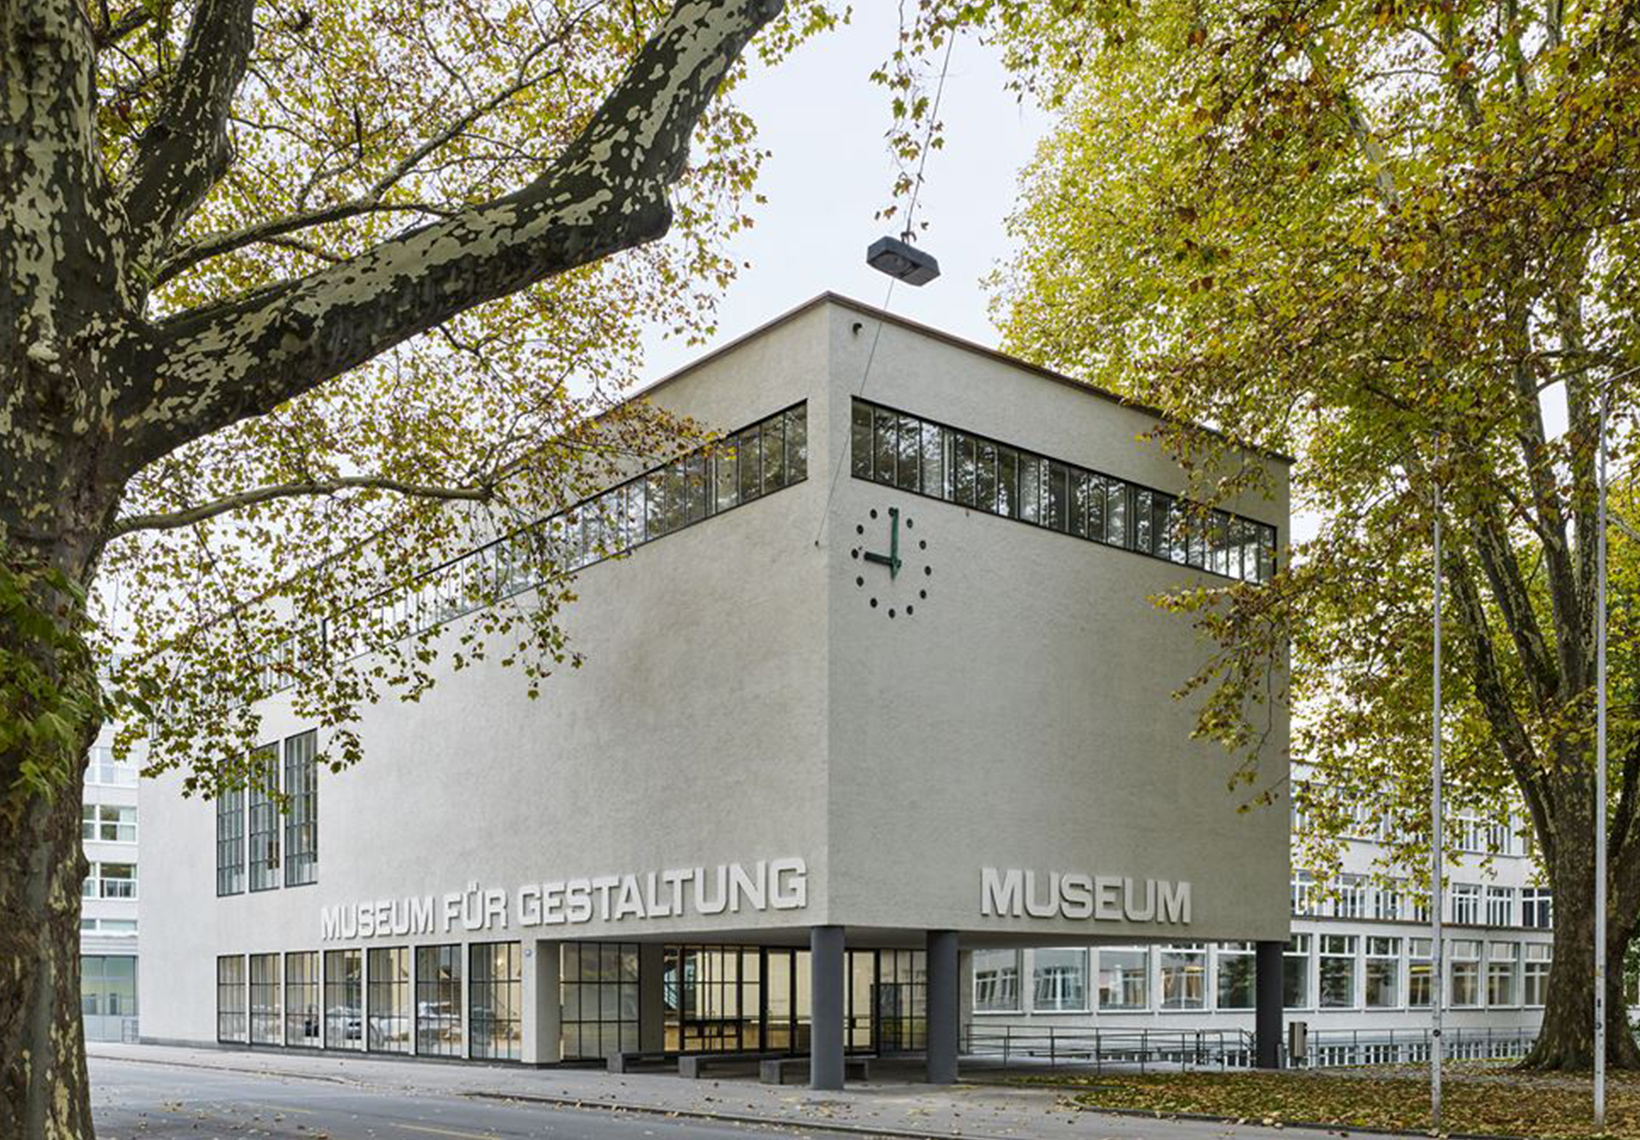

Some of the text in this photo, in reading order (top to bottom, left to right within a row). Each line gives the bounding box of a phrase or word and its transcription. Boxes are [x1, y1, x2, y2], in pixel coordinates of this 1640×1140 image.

[321, 858, 808, 941] MUSEUM FÜR GESTALTUNG
[980, 867, 1192, 924] MUSEUM
